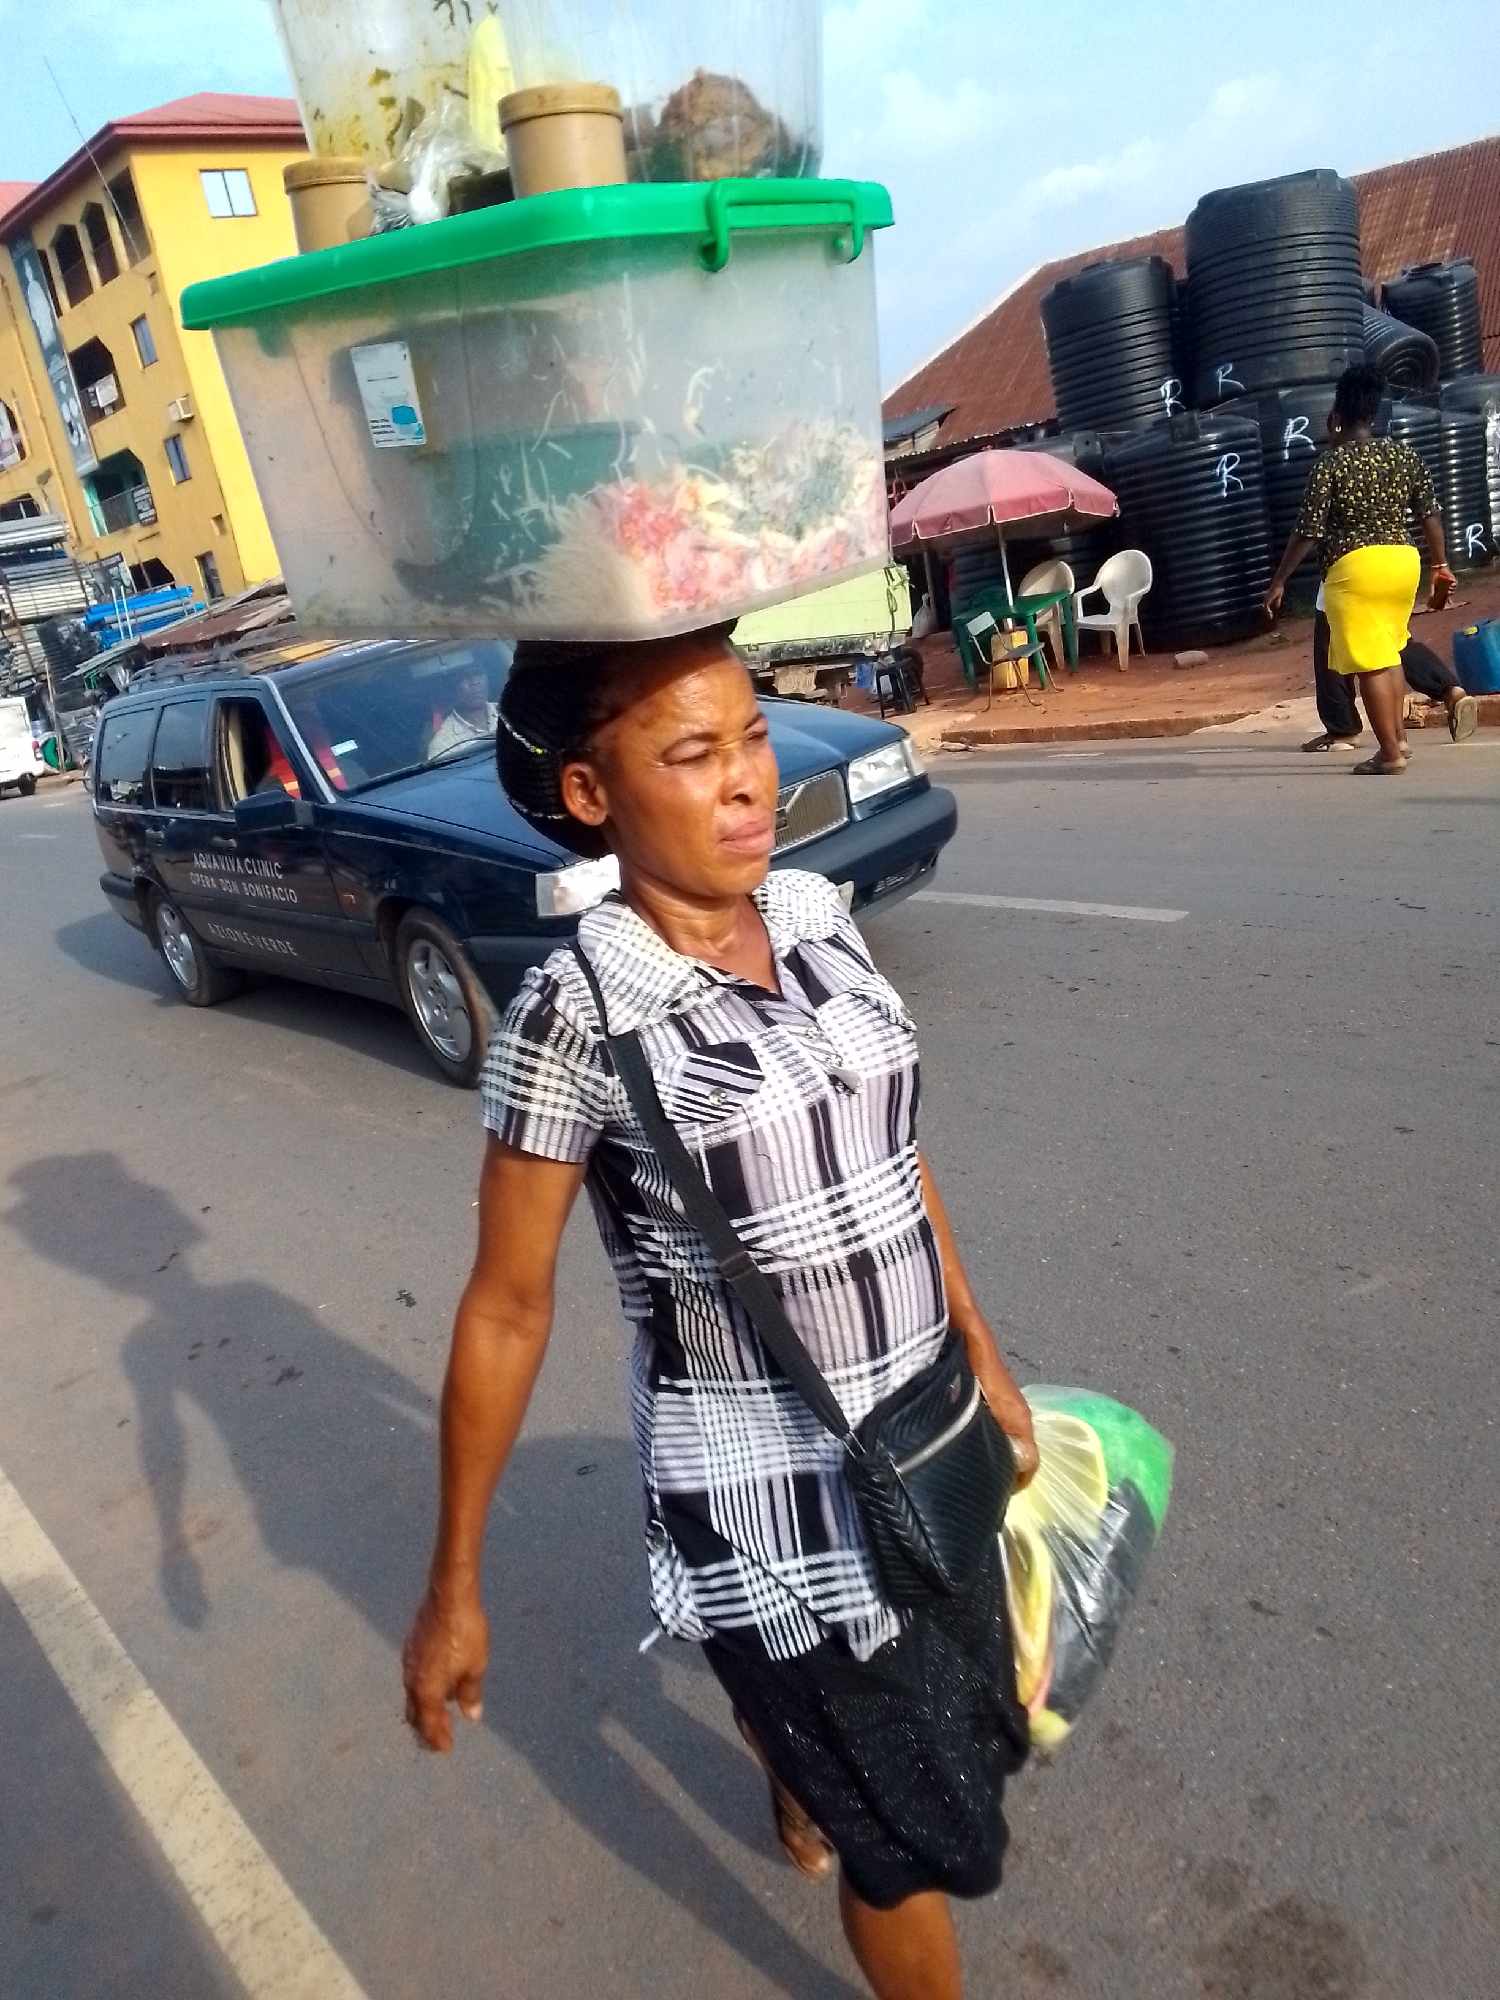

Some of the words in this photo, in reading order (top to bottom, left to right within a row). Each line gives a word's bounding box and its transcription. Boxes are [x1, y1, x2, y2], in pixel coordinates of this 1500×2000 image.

[1160, 378, 1187, 418] R
[1216, 362, 1246, 397] R
[1283, 415, 1317, 461] R
[1216, 452, 1244, 498] R
[1465, 522, 1487, 559] R
[244, 857, 283, 880] CLINIC
[242, 881, 298, 904] BONIFACIO
